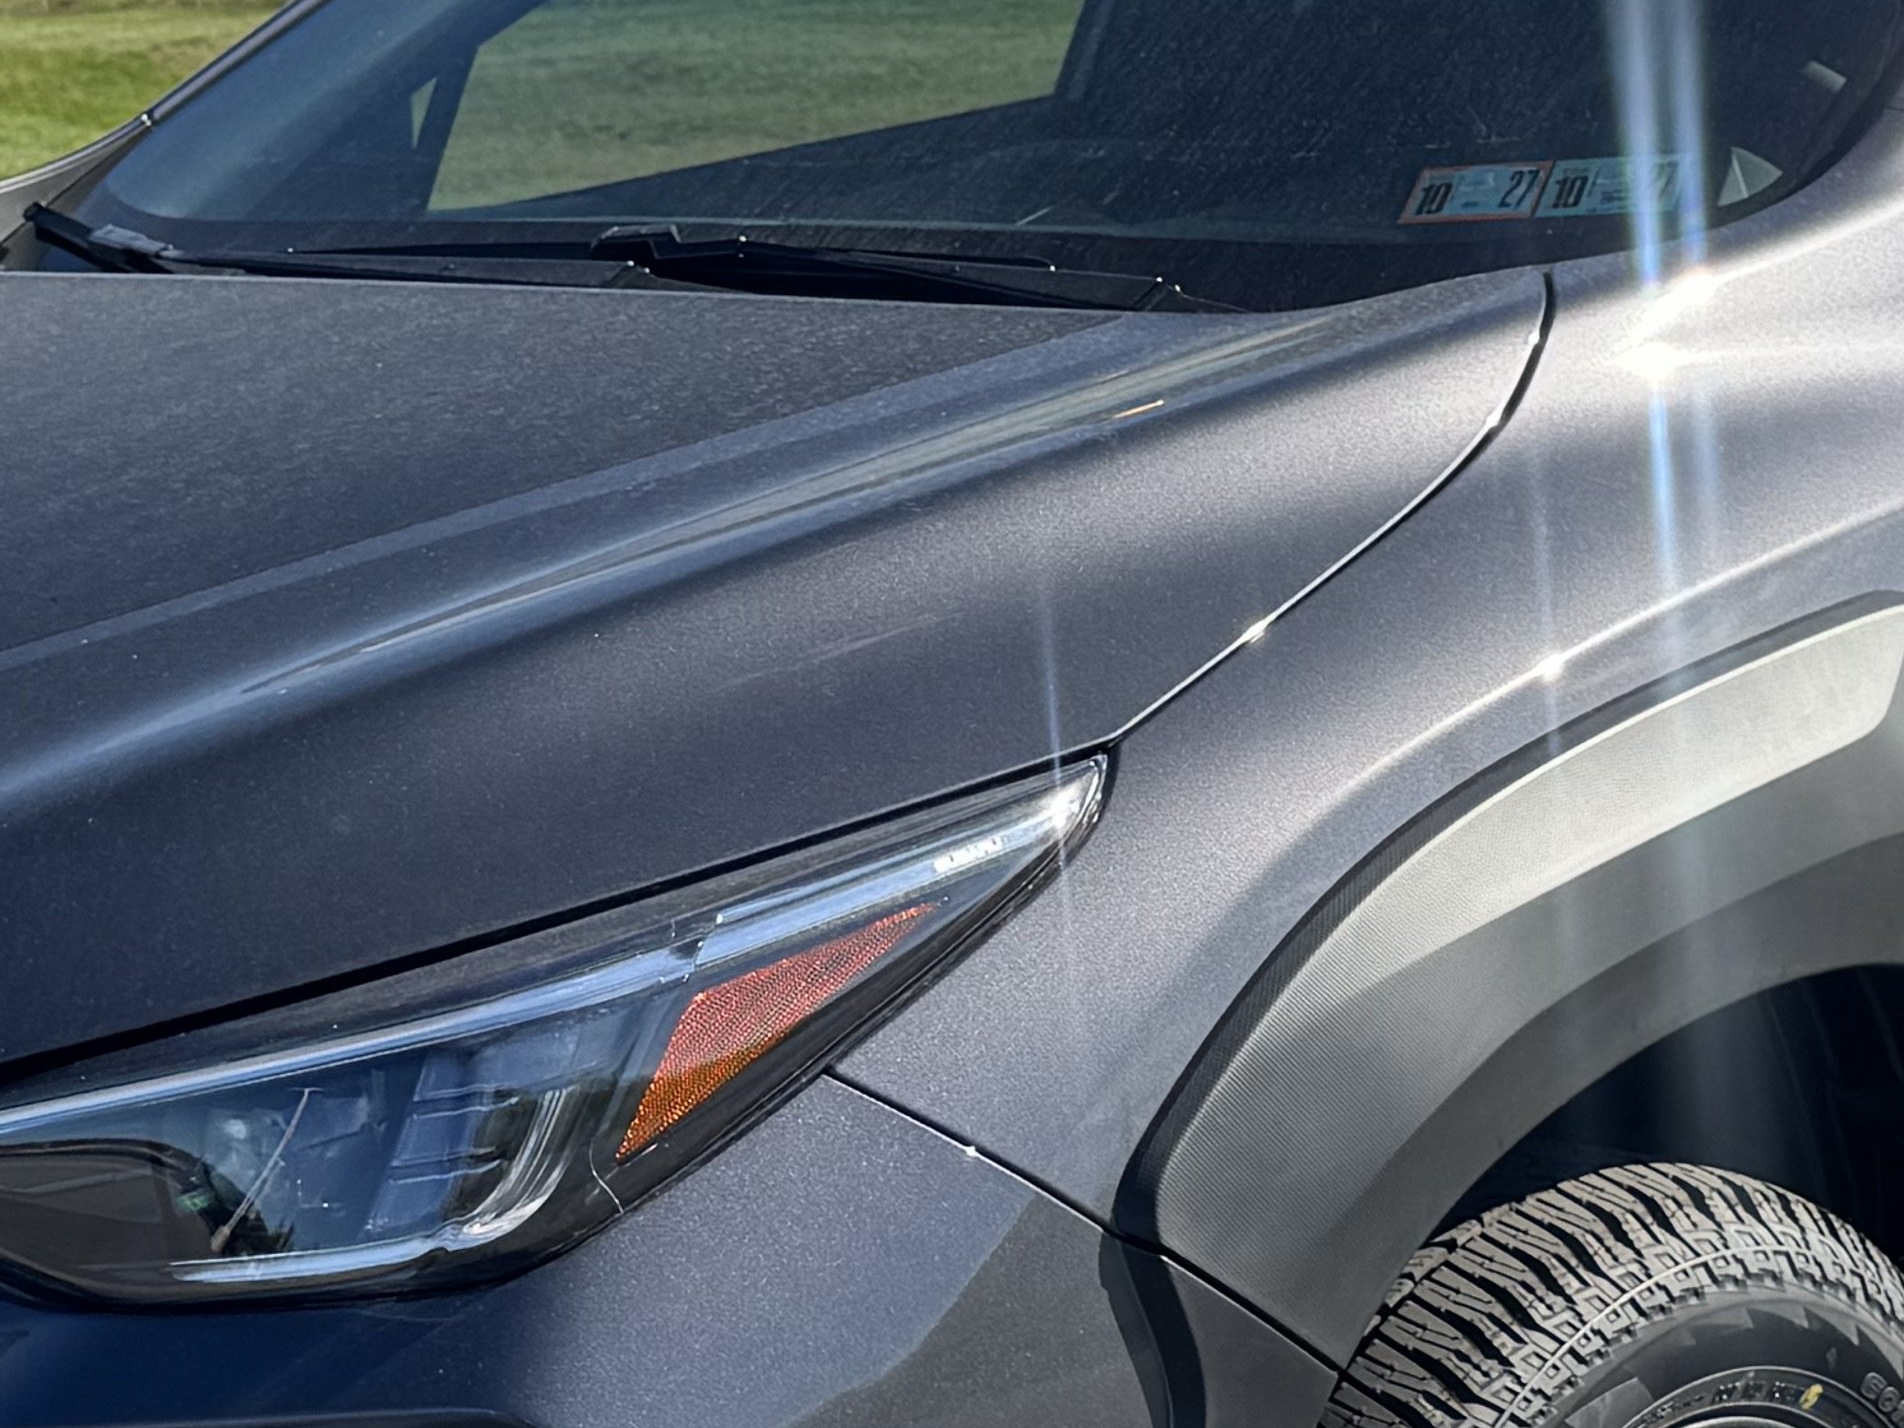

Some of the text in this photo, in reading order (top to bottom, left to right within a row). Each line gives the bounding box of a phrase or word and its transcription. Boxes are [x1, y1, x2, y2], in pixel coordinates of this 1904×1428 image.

[1415, 169, 1541, 215] 10 27
[1552, 175, 1590, 209] 10
